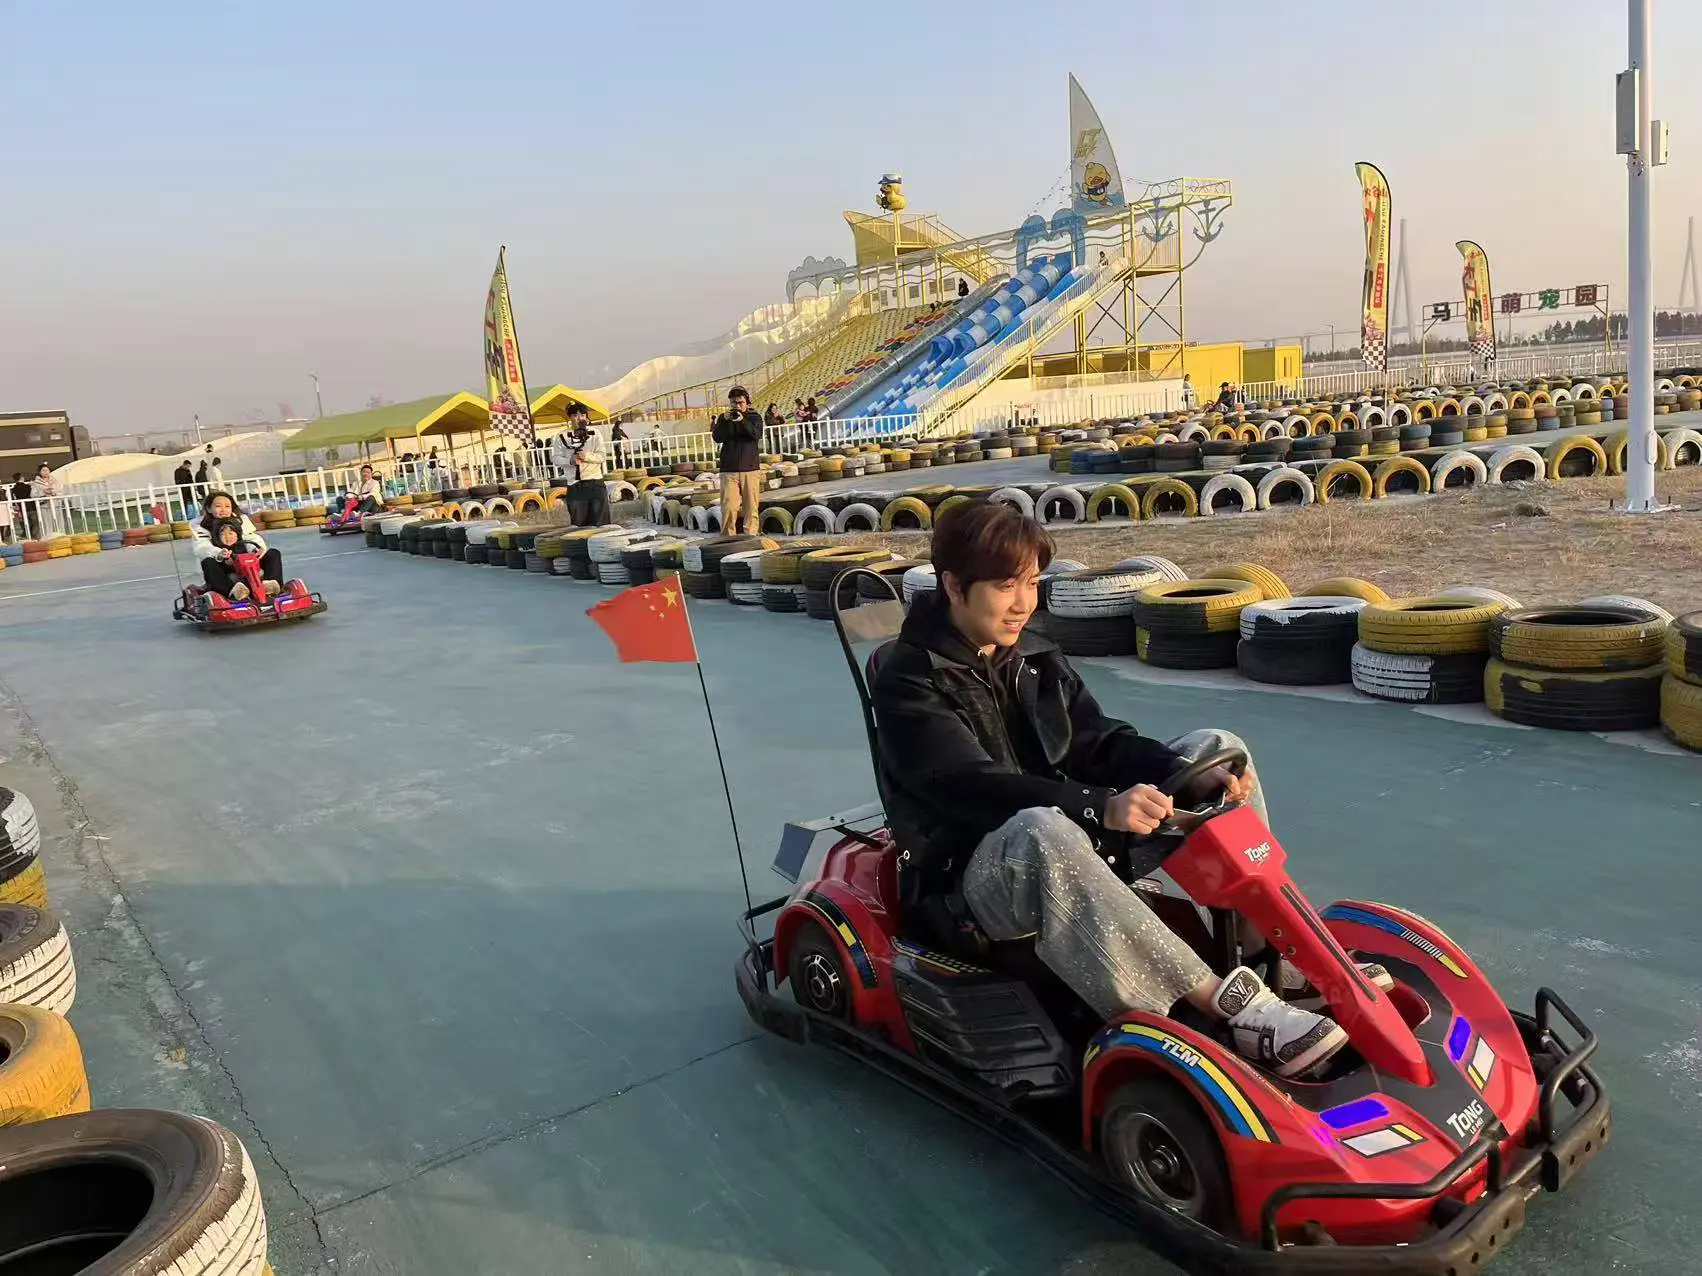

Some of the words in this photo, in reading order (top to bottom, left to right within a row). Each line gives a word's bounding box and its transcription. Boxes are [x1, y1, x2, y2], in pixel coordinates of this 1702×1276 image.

[1431, 284, 1598, 322] 马萌宠园
[1243, 840, 1271, 863] TONG
[1161, 1037, 1200, 1067] TLM
[1446, 1098, 1484, 1138] TONG
